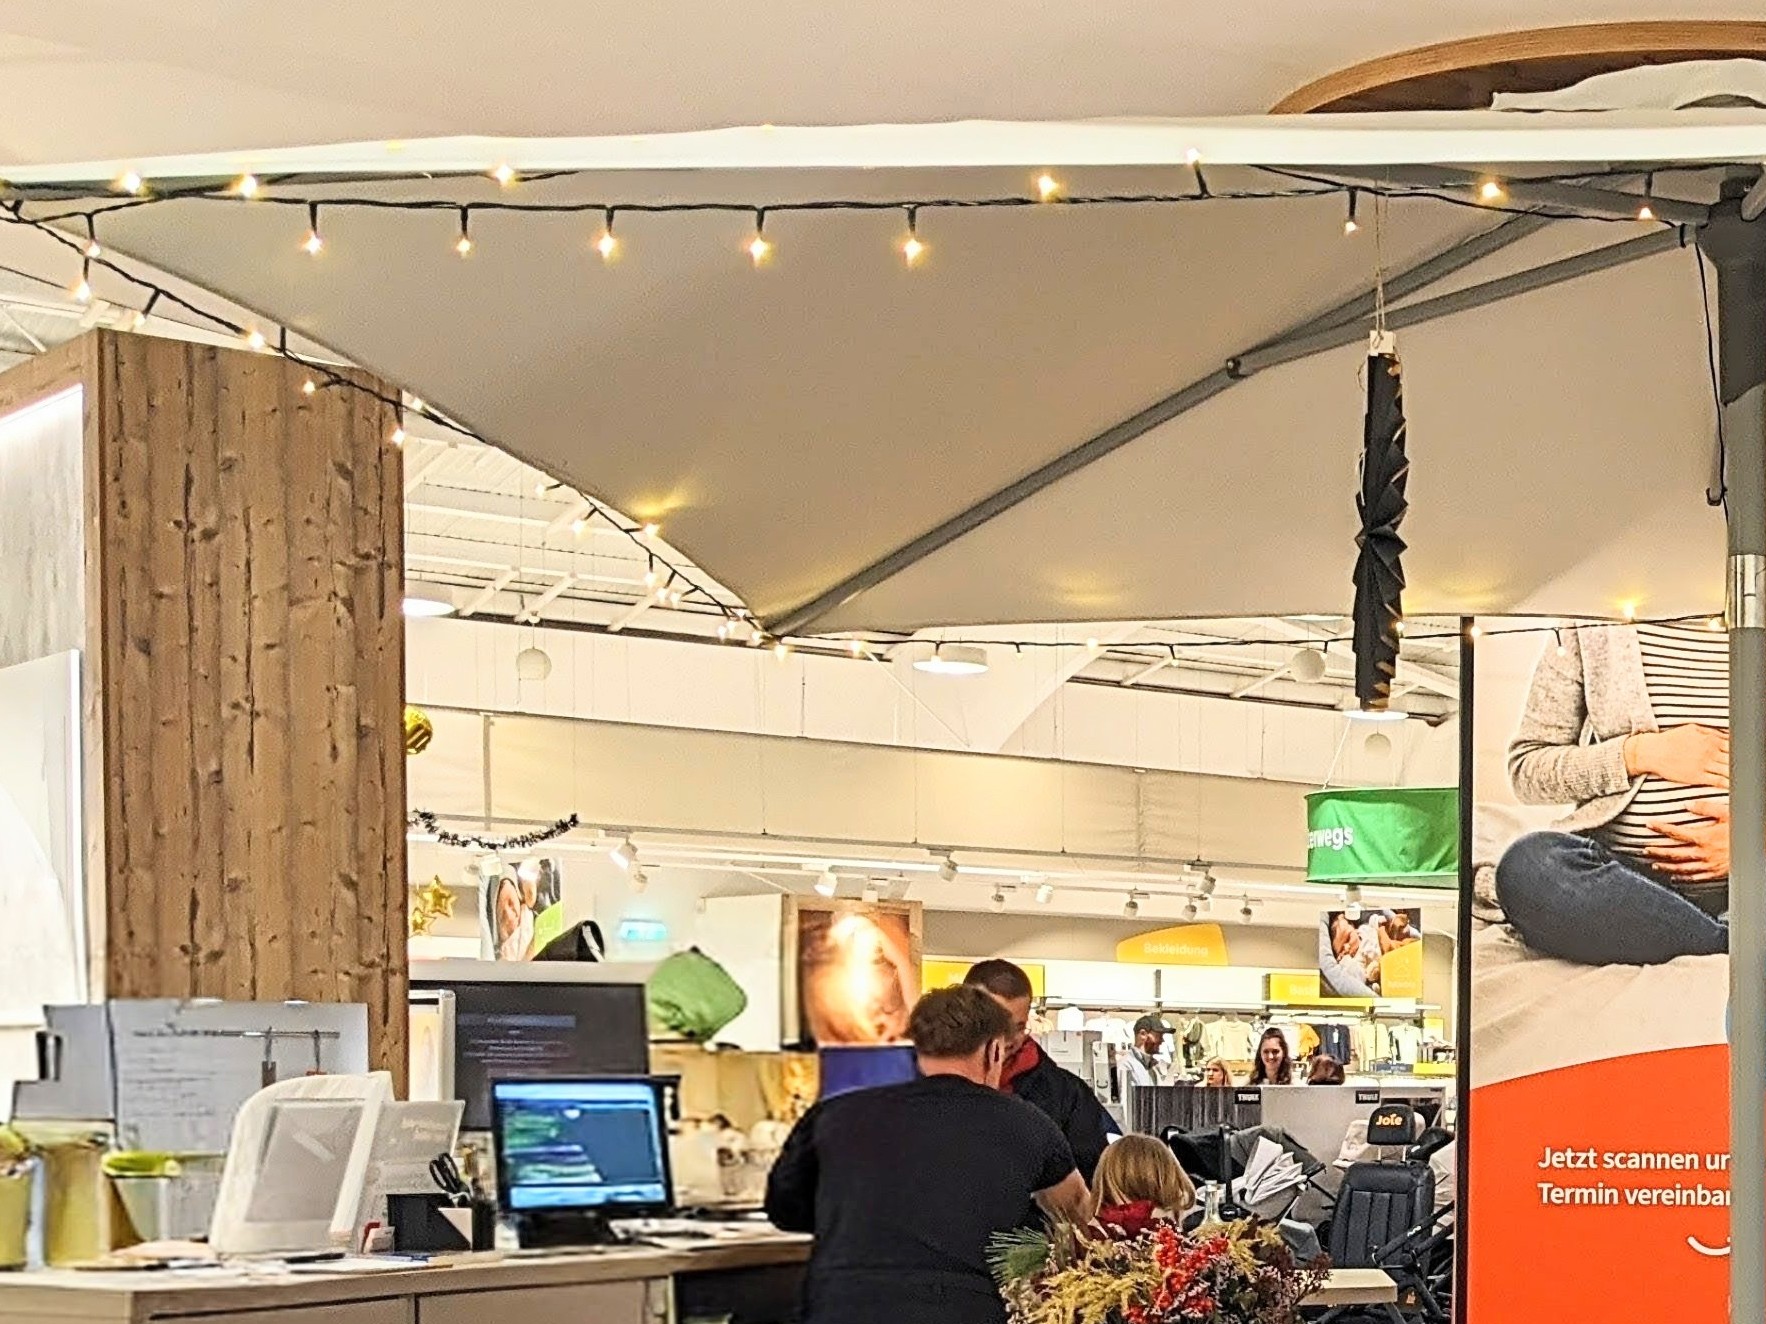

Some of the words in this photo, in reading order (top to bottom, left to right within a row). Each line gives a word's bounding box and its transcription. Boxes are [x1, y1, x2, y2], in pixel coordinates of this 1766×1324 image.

[1538, 1147, 1598, 1169] Jetzt
[1602, 1150, 1699, 1170] scannen
[1537, 1182, 1619, 1205] Termin
